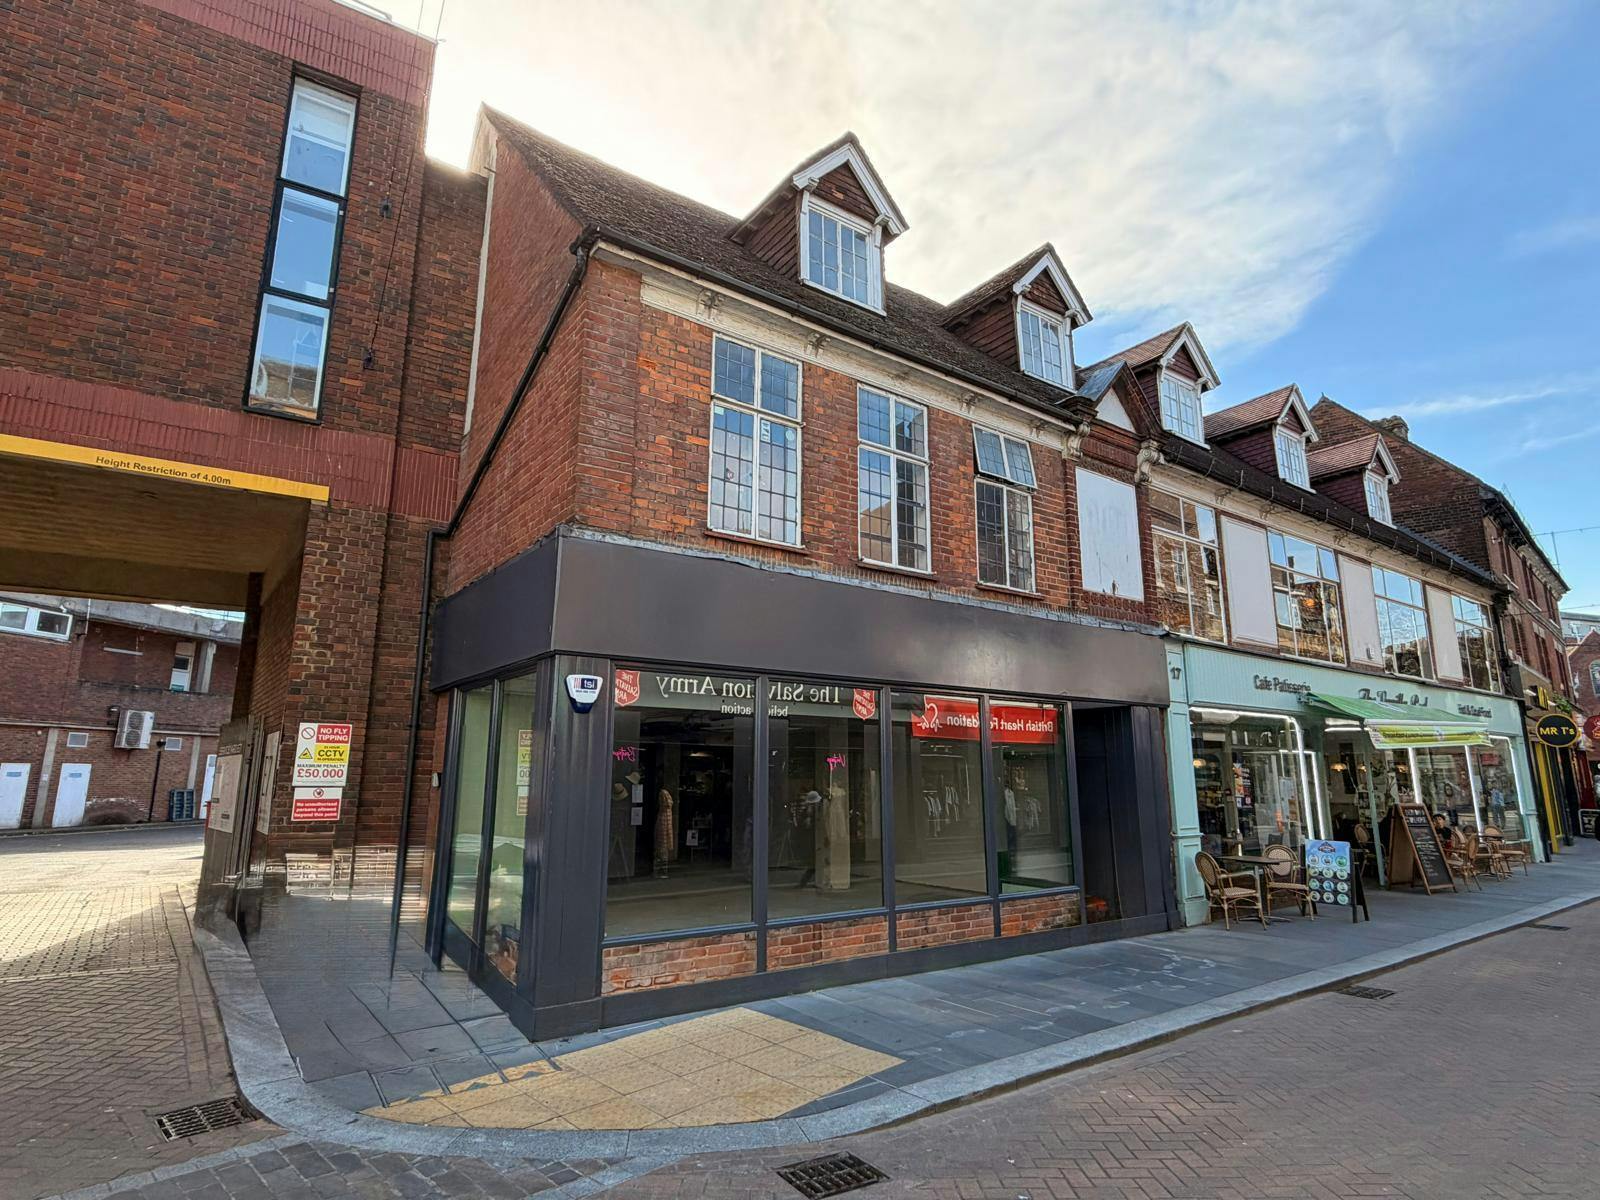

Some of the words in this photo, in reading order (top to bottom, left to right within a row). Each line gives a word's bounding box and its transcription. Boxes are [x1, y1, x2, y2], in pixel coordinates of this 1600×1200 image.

[96, 456, 130, 468] Height
[133, 462, 188, 477] Restriction
[202, 474, 231, 485] 4.00m
[1170, 666, 1182, 680] 17
[1540, 727, 1558, 735] MR
[297, 768, 344, 778] £50,000
